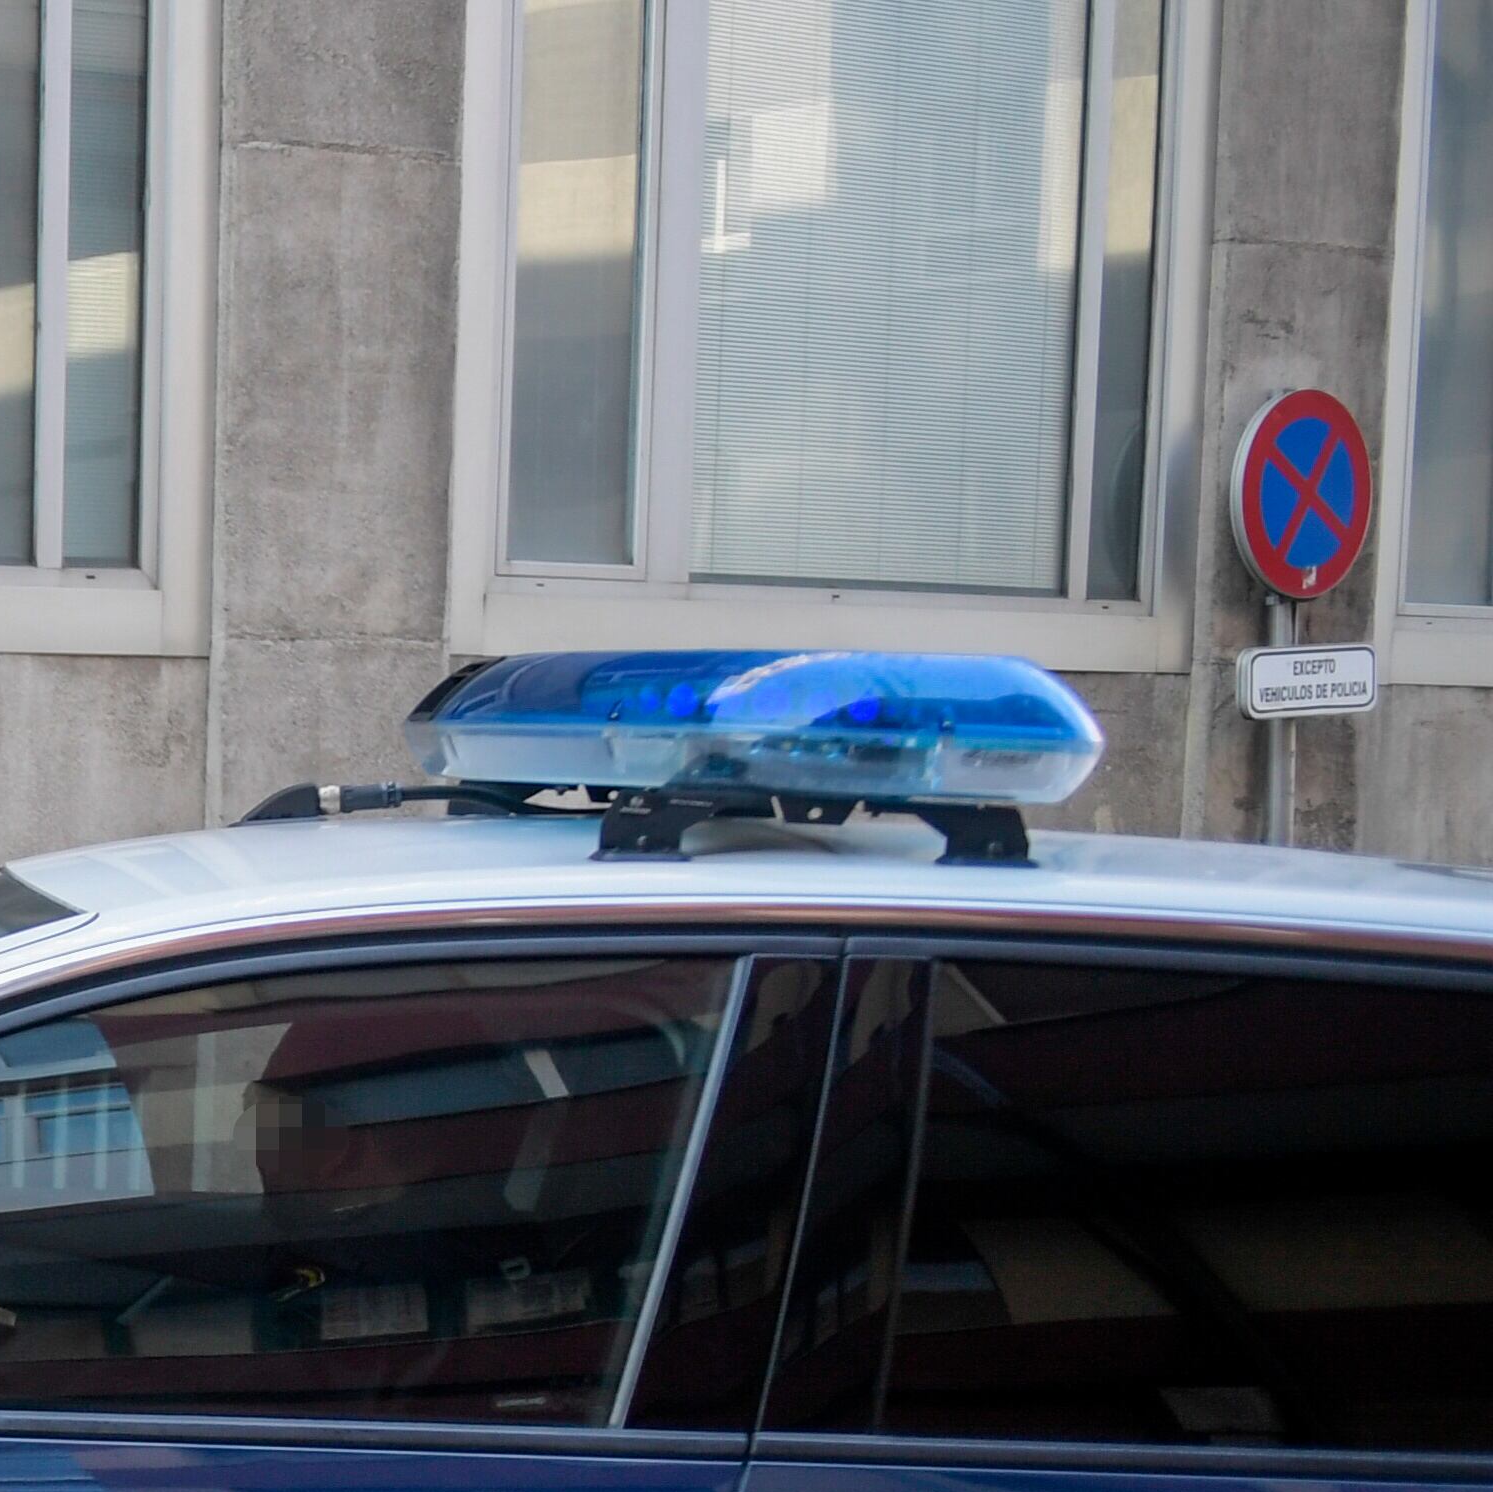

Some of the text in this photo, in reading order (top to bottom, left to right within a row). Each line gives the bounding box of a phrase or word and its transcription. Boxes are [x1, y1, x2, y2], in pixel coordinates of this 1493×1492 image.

[1293, 658, 1336, 676] EXCEPTO
[1259, 680, 1368, 703] VEHICULOS DE POLICIA
